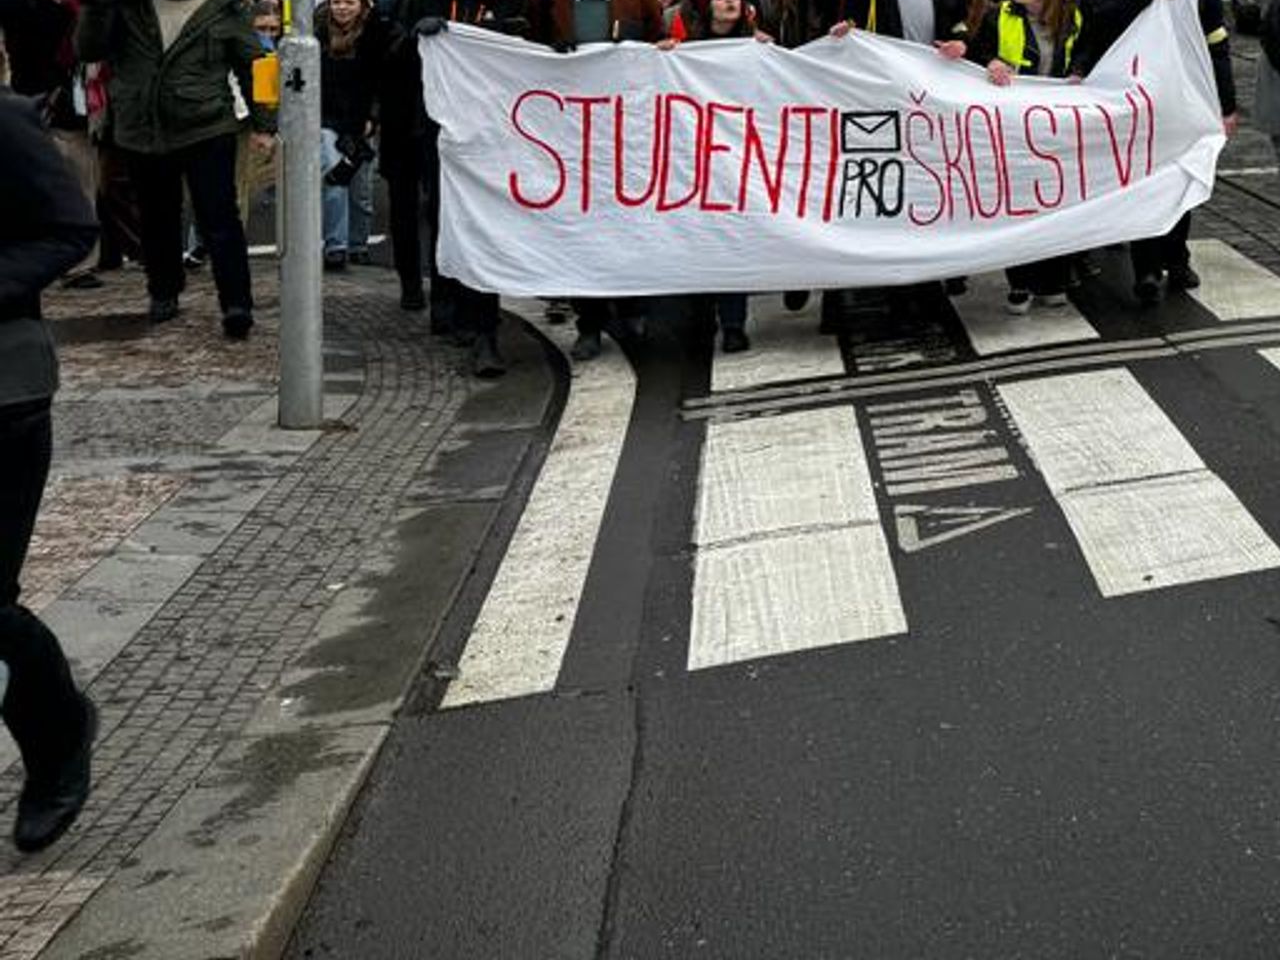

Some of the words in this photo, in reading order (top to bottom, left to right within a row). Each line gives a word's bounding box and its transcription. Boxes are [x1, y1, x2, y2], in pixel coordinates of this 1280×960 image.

[509, 89, 840, 222] STUDENTI
[838, 158, 904, 218] PRO
[907, 56, 1155, 227] ŠKOLSTVÍ
